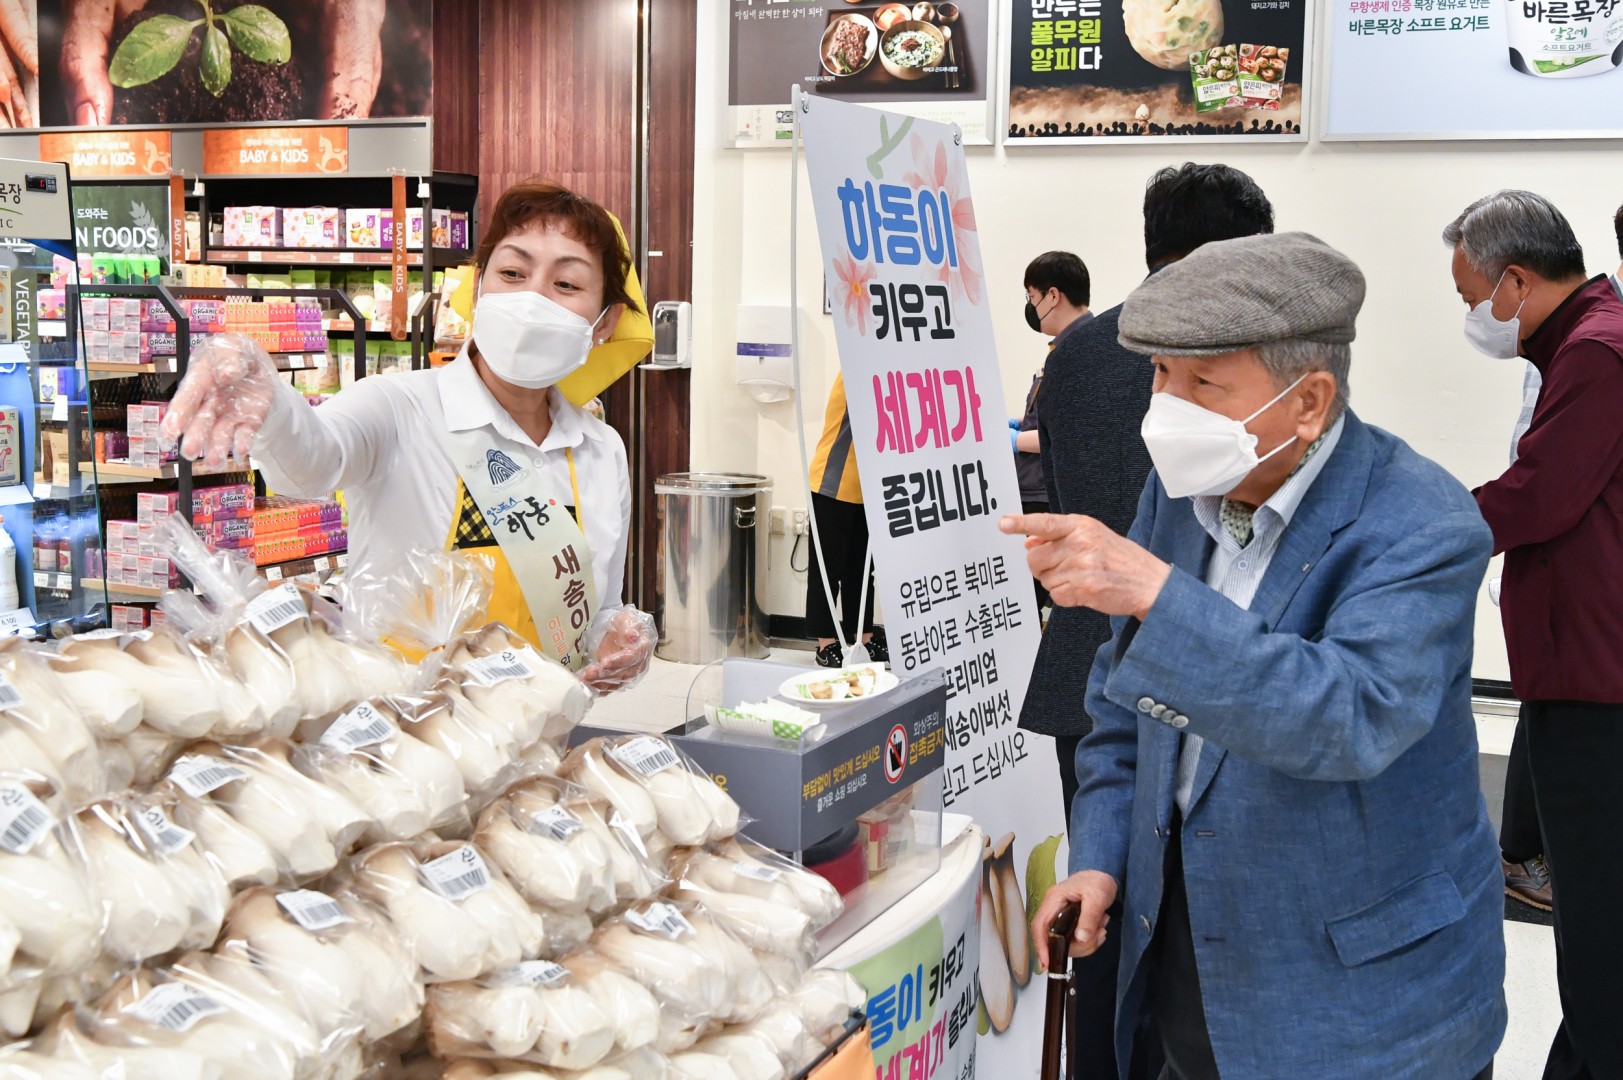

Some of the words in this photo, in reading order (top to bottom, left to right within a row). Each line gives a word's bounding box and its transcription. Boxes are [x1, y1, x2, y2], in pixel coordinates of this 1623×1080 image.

[758, 8, 780, 19] 완벽한
[782, 8, 790, 18] 한
[792, 7, 806, 18] 상이
[808, 6, 824, 18] 되다
[1279, 1, 1290, 9] 김치
[1350, 1, 1389, 13] 무항생제
[1391, 0, 1412, 12] 인증
[1414, 0, 1434, 11] 목장
[1436, 0, 1468, 10] 원유로
[1523, 0, 1620, 24] 바른목장
[1031, 18, 1101, 45] 풀무원
[1349, 18, 1404, 35] 바른목장
[1406, 17, 1447, 32] 소프트
[1449, 15, 1490, 32] 요거트
[1550, 26, 1588, 41] 알로에
[1031, 46, 1103, 72] 얄피다
[1541, 43, 1592, 51] 소프트요거트
[73, 153, 99, 166] BABY
[101, 157, 109, 165] &
[110, 151, 136, 165] KIDS
[239, 150, 269, 163] BABY
[271, 153, 278, 162] &
[281, 149, 309, 163] KIDS
[77, 208, 108, 220] 도와주는
[836, 177, 958, 268] 하동이
[94, 226, 158, 248] FOODS
[174, 219, 182, 247] BABY
[192, 307, 218, 315] ORGANIC
[869, 282, 956, 342] 키우고
[872, 365, 984, 454] 세계가
[221, 494, 246, 503] ORGANIC
[881, 459, 998, 538] 즐깁니다.
[224, 524, 248, 533] ORGANIC
[506, 496, 550, 541] 하동
[551, 544, 590, 654] 새송이
[900, 569, 962, 619] 유럽으로
[964, 555, 1009, 594] 북미로
[900, 618, 962, 671] 동남아로
[964, 597, 1022, 644] 수출되는
[913, 711, 940, 736] 화상주의
[944, 689, 1013, 751] 새송이버섯
[909, 727, 945, 766] 접촉금지
[972, 731, 1029, 785] 드십시오
[802, 770, 831, 801] 부담없이
[833, 758, 853, 784] 맛있게
[855, 745, 881, 772] 드십시오
[817, 791, 834, 813] 즐거운
[834, 784, 846, 802] 쇼핑
[847, 773, 868, 794] 되십시오
[866, 963, 923, 1049] 동이
[929, 932, 965, 1007] 키우고
